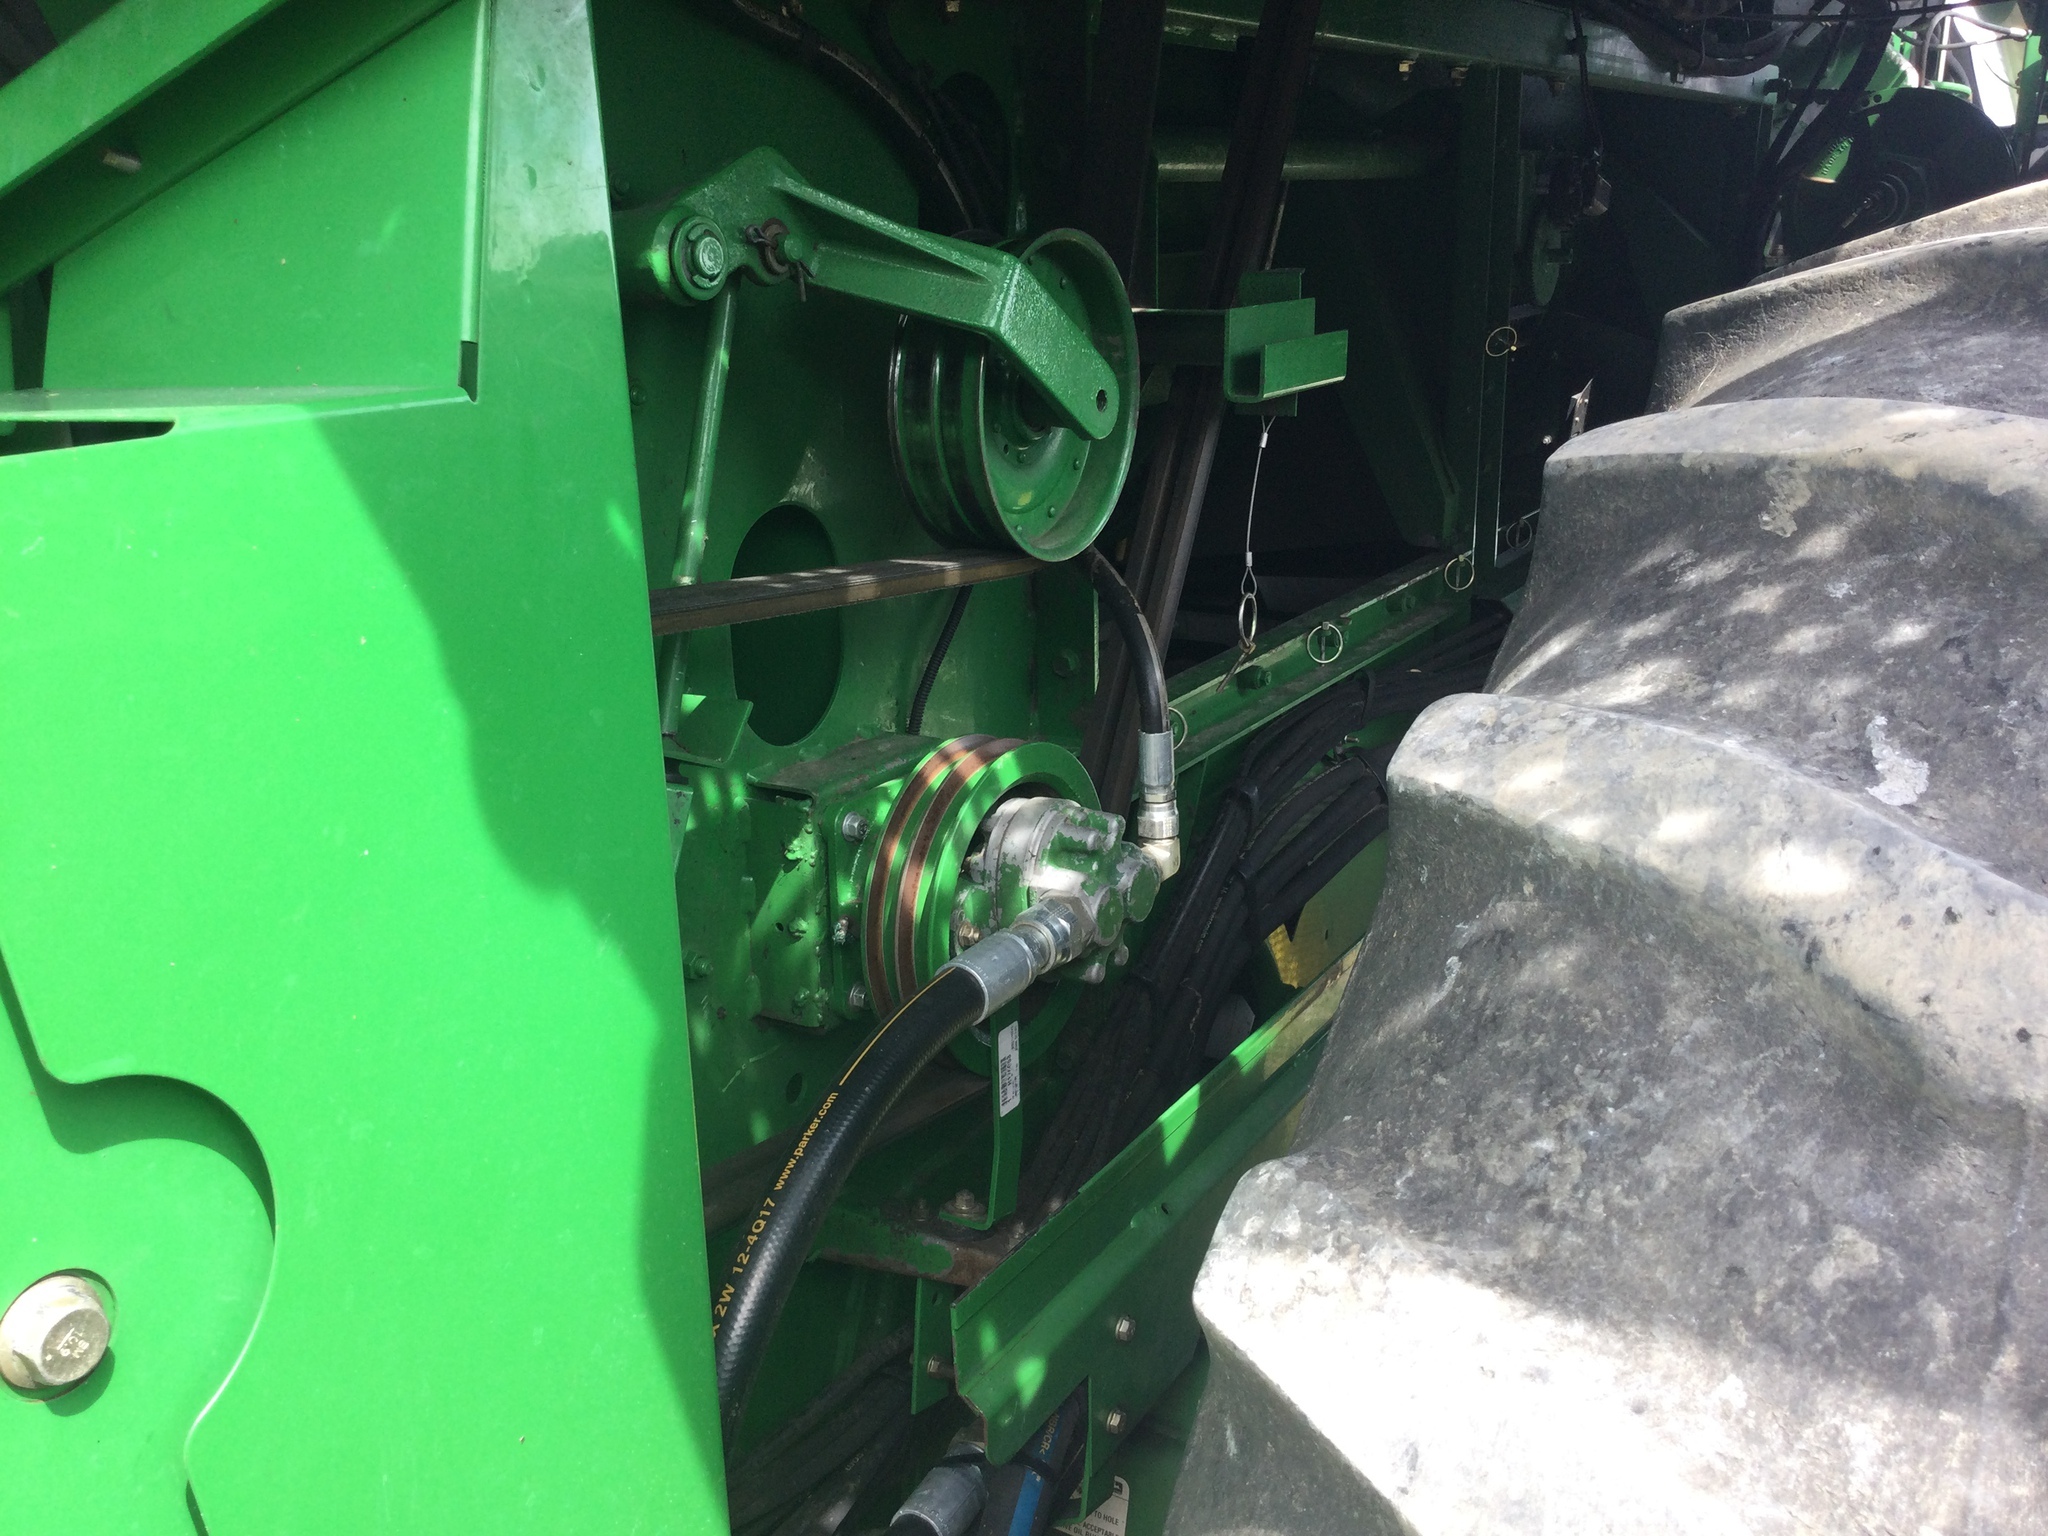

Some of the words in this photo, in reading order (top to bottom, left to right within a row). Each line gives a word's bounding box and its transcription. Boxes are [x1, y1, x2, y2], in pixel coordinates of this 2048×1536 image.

[715, 1283, 735, 1317] 2W
[733, 1197, 775, 1273] 12-4Q17
[774, 1092, 839, 1191] www.parker.com
[1103, 1514, 1119, 1526] HOLE
[1083, 1522, 1119, 1536] ACCEPTAB
